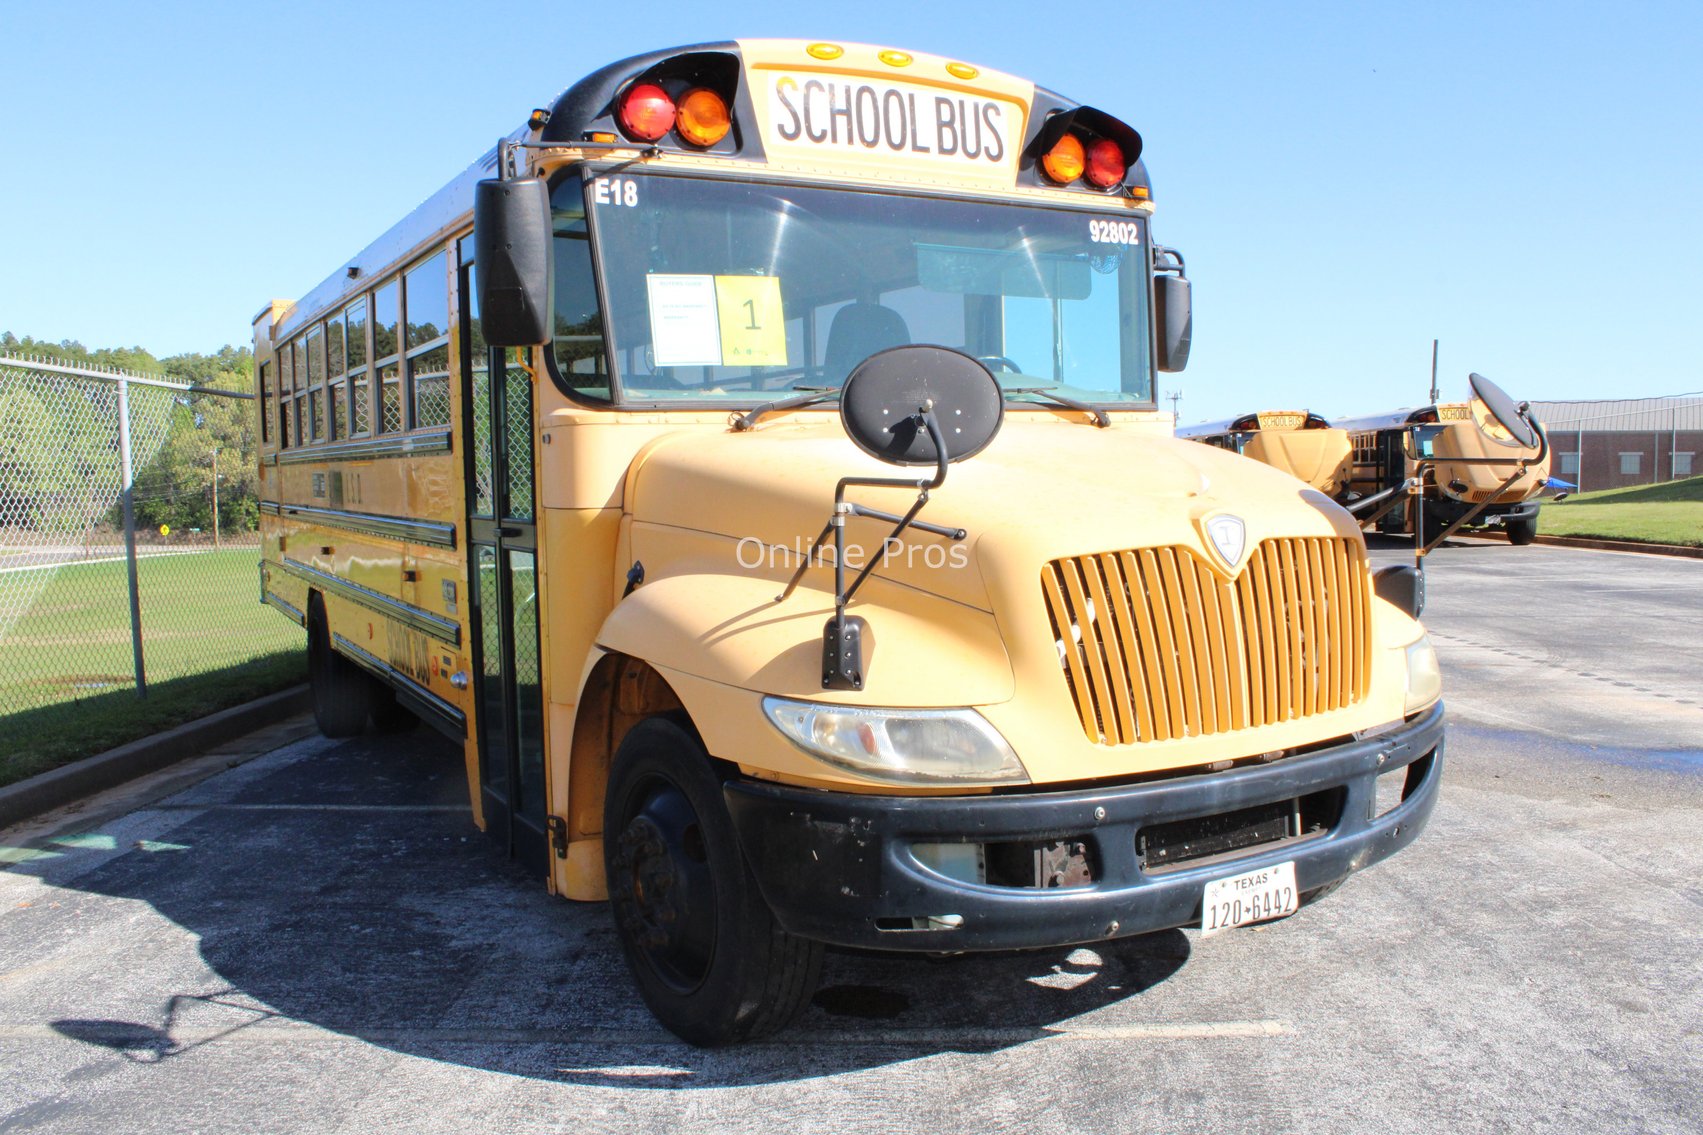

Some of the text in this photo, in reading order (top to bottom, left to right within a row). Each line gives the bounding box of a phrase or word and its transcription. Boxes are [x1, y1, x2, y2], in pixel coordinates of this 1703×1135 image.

[775, 76, 1004, 162] SCHOOL BUS
[594, 177, 639, 207] E18
[1089, 219, 1139, 245] 92802
[742, 299, 763, 330] 1
[1263, 415, 1302, 427] SCHOOL BUS
[1441, 408, 1470, 420] SCHOOL
[1234, 873, 1268, 890] TEXAS
